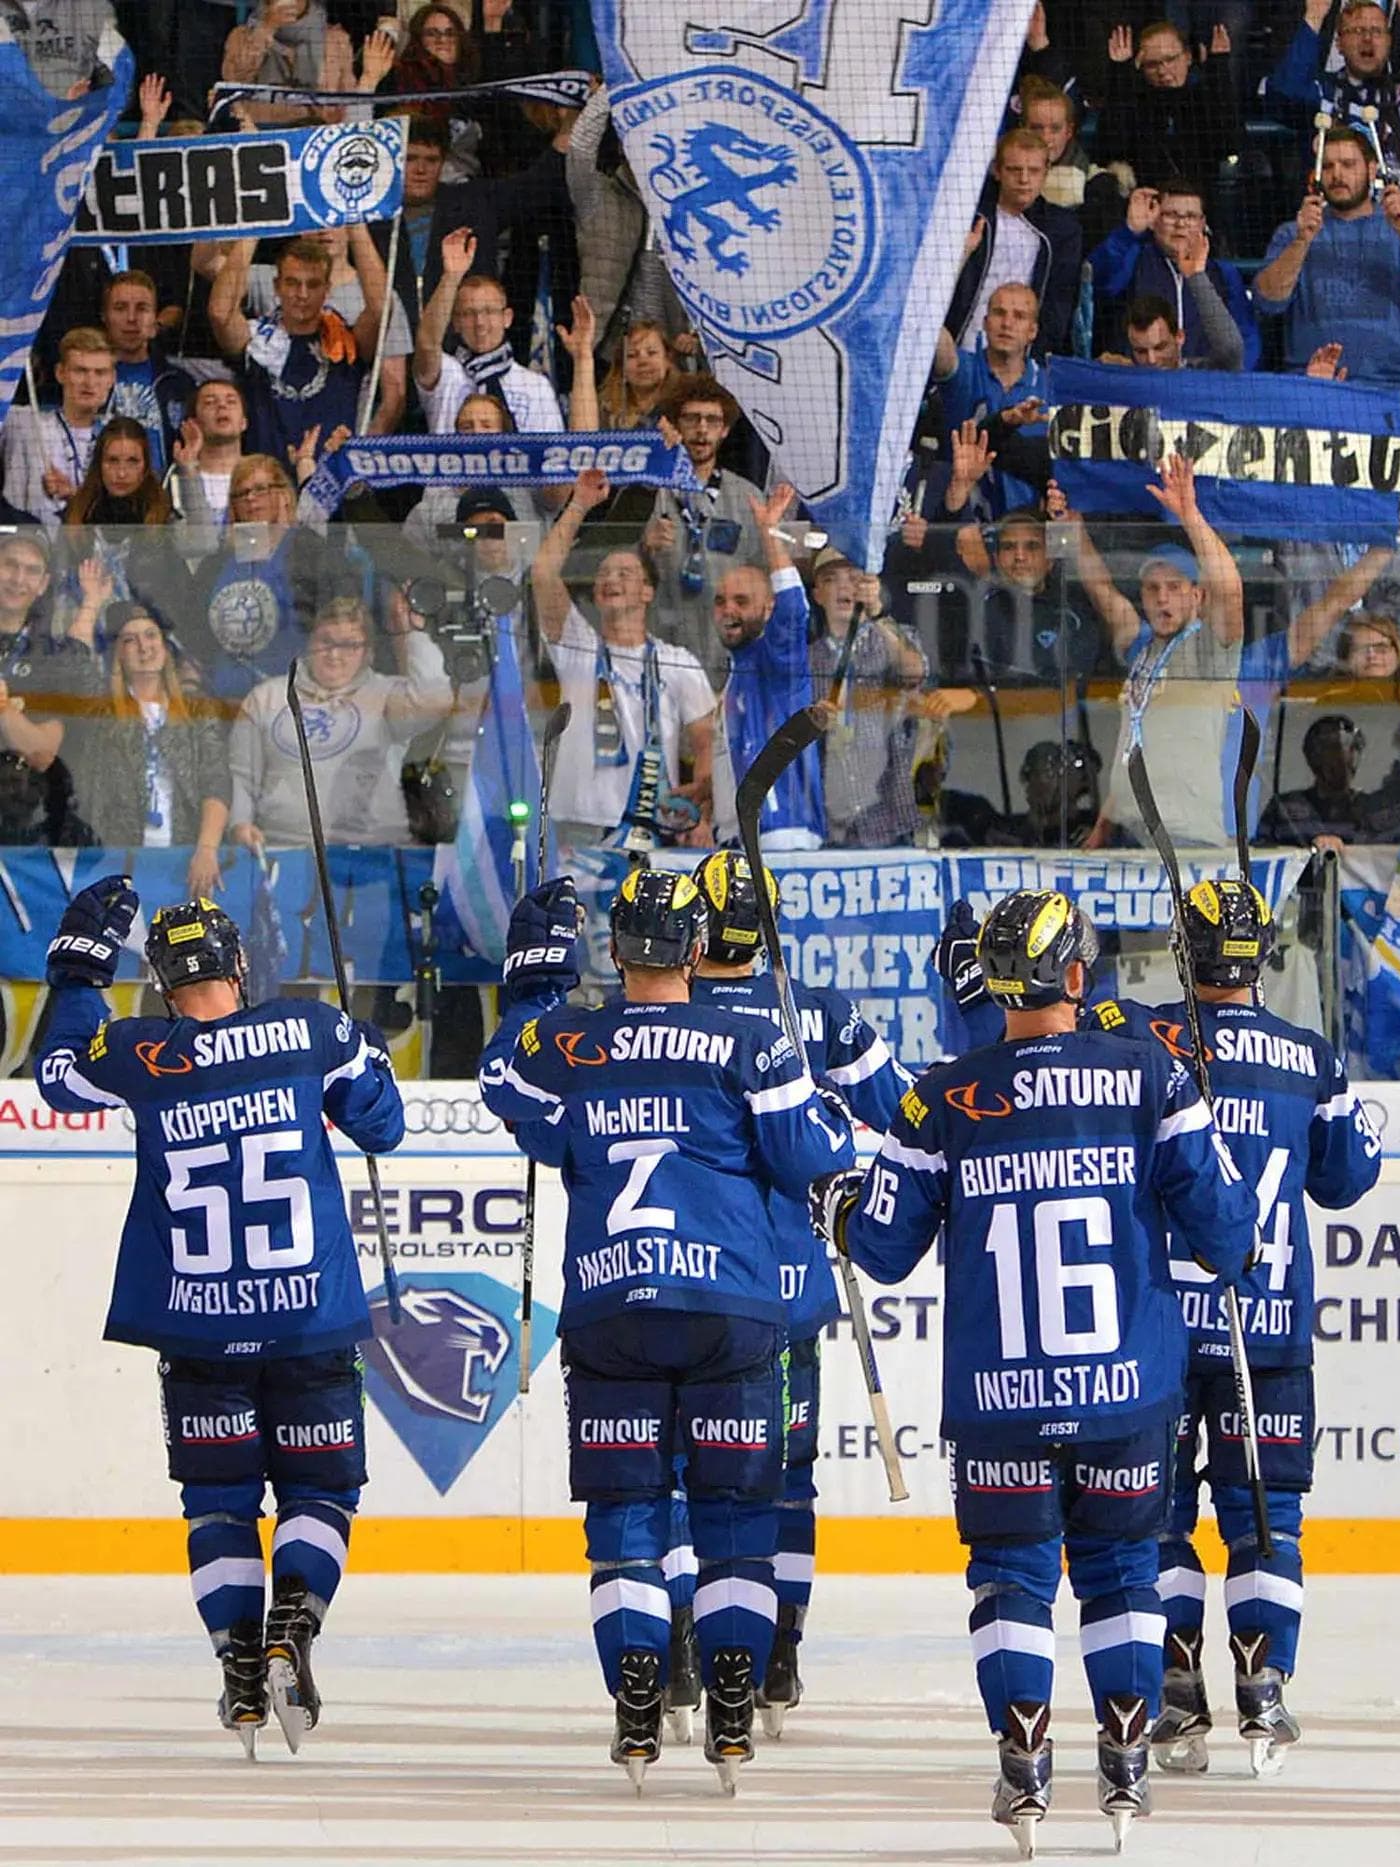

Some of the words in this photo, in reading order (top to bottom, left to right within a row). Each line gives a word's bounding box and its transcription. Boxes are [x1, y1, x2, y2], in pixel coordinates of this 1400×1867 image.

[193, 1018, 312, 1068] SATURN
[610, 1025, 735, 1067] SATURN
[1215, 1029, 1318, 1077] SATURN
[1013, 1067, 1142, 1108] SATURN
[160, 1088, 297, 1143] KÖPPCHEN
[605, 1138, 679, 1235] 2
[863, 1165, 898, 1226] 16
[959, 1145, 1137, 1199] BUCHWIESER
[164, 1130, 314, 1275] 55
[576, 1236, 722, 1292] INGOLSTADT
[985, 1196, 1121, 1360] 16
[167, 1271, 322, 1316] INGOLSTADT
[974, 1359, 1141, 1412] INGOLSTADT
[182, 1410, 257, 1440] CINQUE
[276, 1419, 354, 1448] CINQUE
[580, 1417, 662, 1444] CINQUE
[966, 1459, 1053, 1487] CINQUE
[1074, 1461, 1161, 1493] CINQUE
